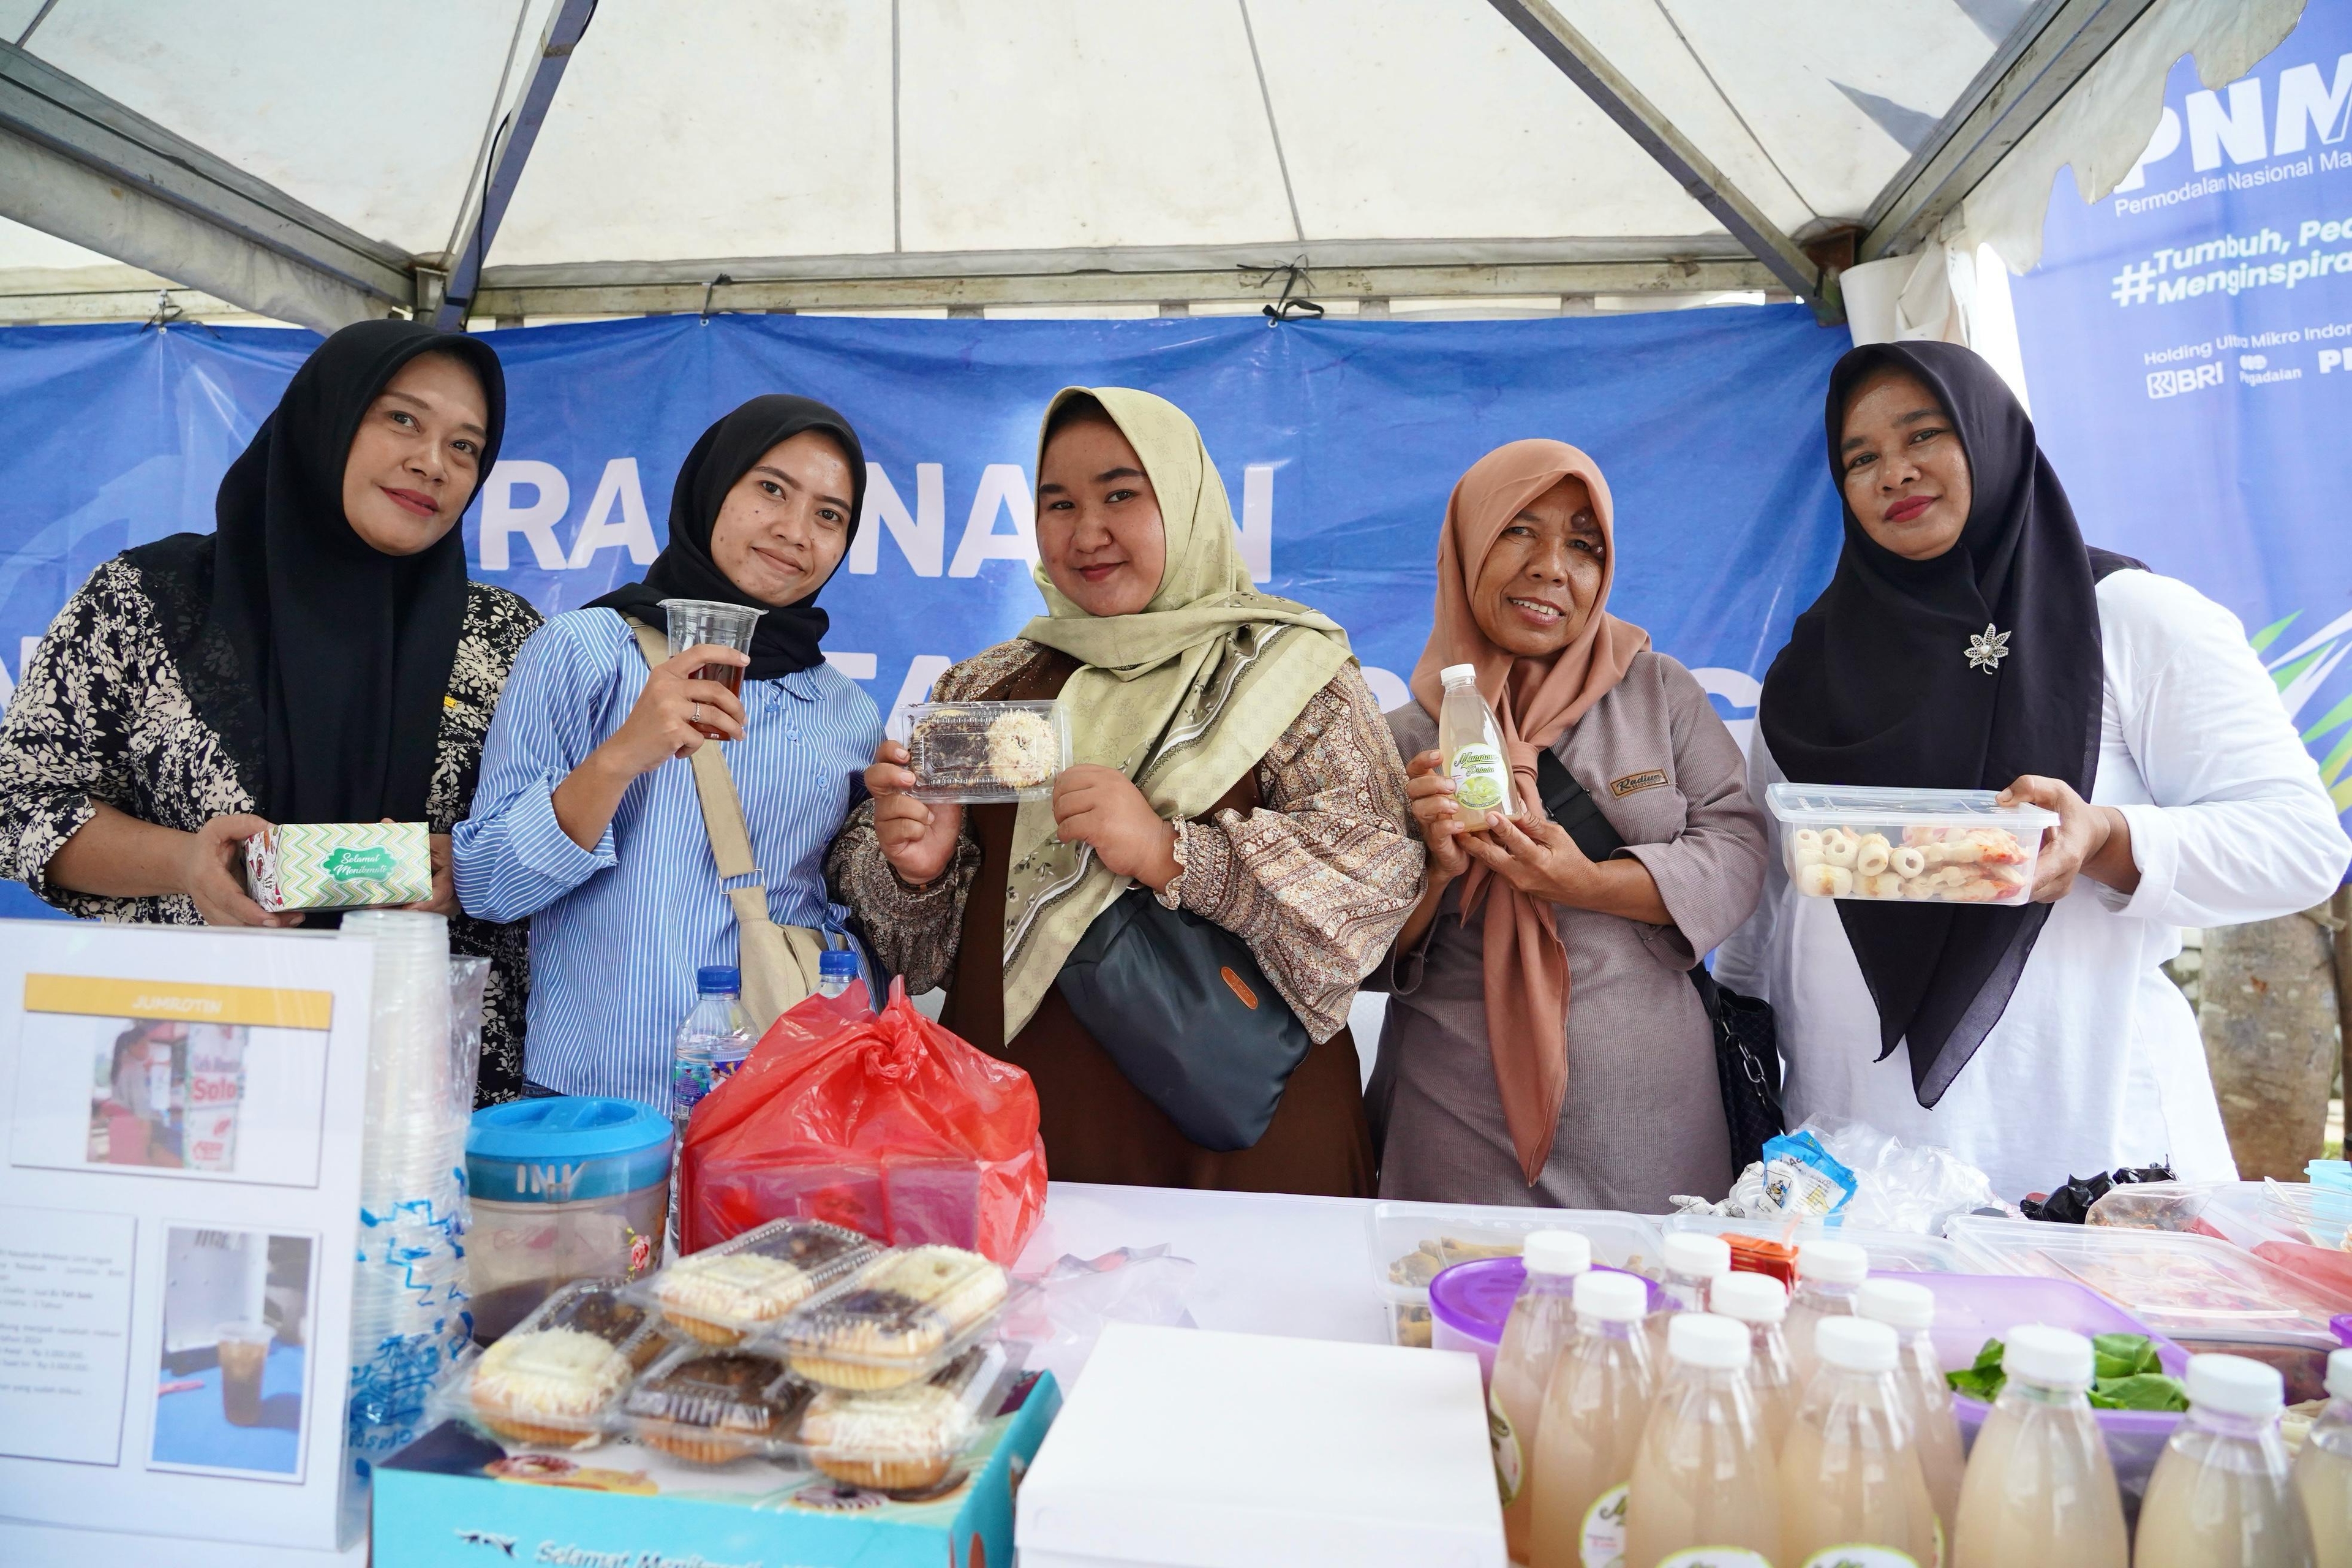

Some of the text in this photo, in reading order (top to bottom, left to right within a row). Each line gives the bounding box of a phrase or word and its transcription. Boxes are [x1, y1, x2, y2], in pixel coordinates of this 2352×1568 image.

[2114, 53, 2352, 194] PNM
[2114, 176, 2226, 217] Permodalan
[2227, 155, 2314, 191] Nasional
[2144, 342, 2213, 366] Holding
[2215, 334, 2249, 351] Ultra
[2251, 330, 2301, 349] Mikro
[2176, 360, 2224, 394] BRI
[341, 852, 380, 864] Selamat
[192, 1076, 238, 1101] Solo
